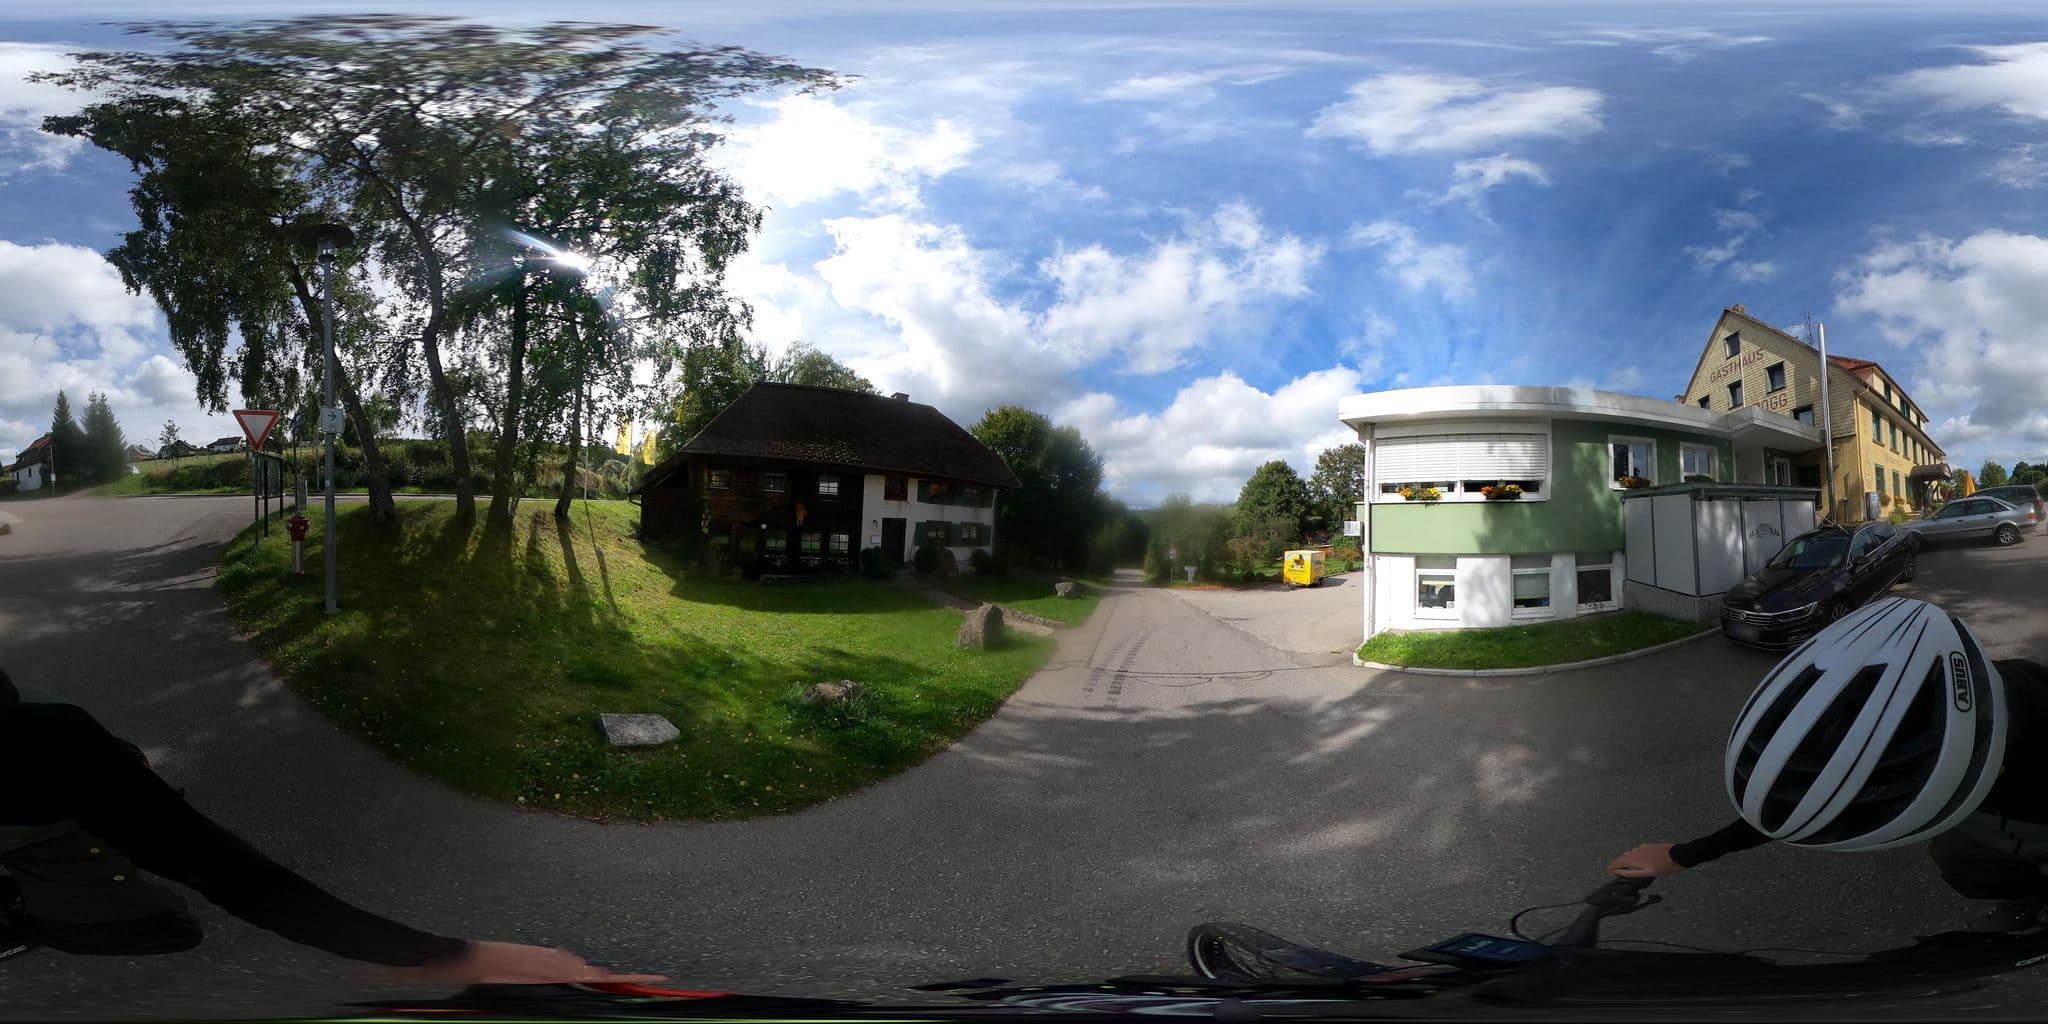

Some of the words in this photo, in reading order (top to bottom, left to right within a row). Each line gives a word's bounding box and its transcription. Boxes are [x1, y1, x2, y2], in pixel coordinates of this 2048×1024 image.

[1710, 347, 1764, 383] GASTHAUS
[1753, 393, 1788, 410] OGG
[1953, 658, 1969, 704] ABUS
